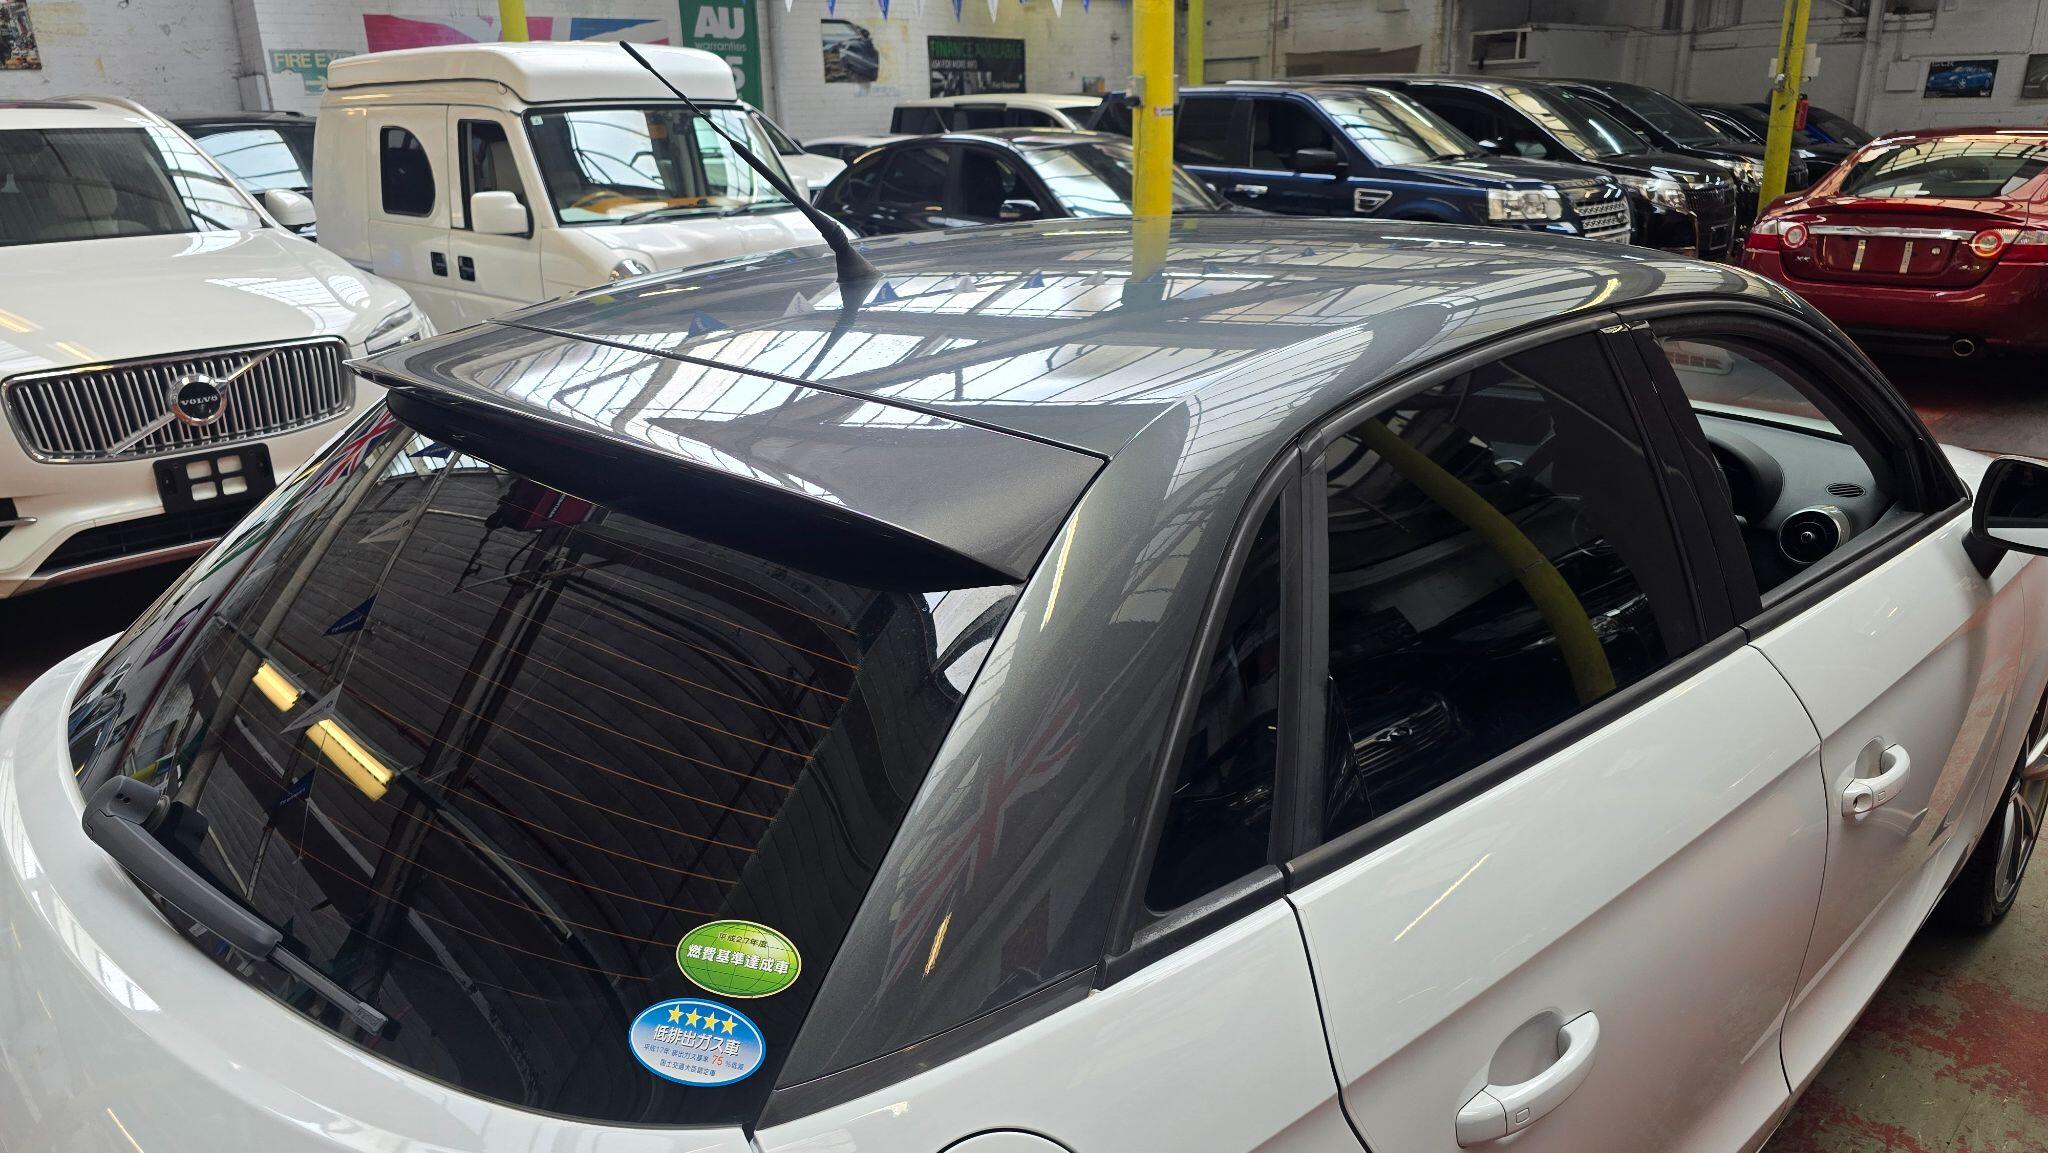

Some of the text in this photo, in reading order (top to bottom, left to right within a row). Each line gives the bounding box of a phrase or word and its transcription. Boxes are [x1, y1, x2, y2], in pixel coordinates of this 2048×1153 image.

[693, 6, 746, 40] AU
[694, 41, 748, 52] warranties
[273, 52, 313, 68] FIRE
[180, 395, 218, 406] VOLVO
[719, 932, 769, 949] 平成27年度
[686, 943, 790, 976] 燃費基準達成車
[653, 1024, 741, 1057] 低排出ガス車
[711, 1054, 725, 1066] 75
